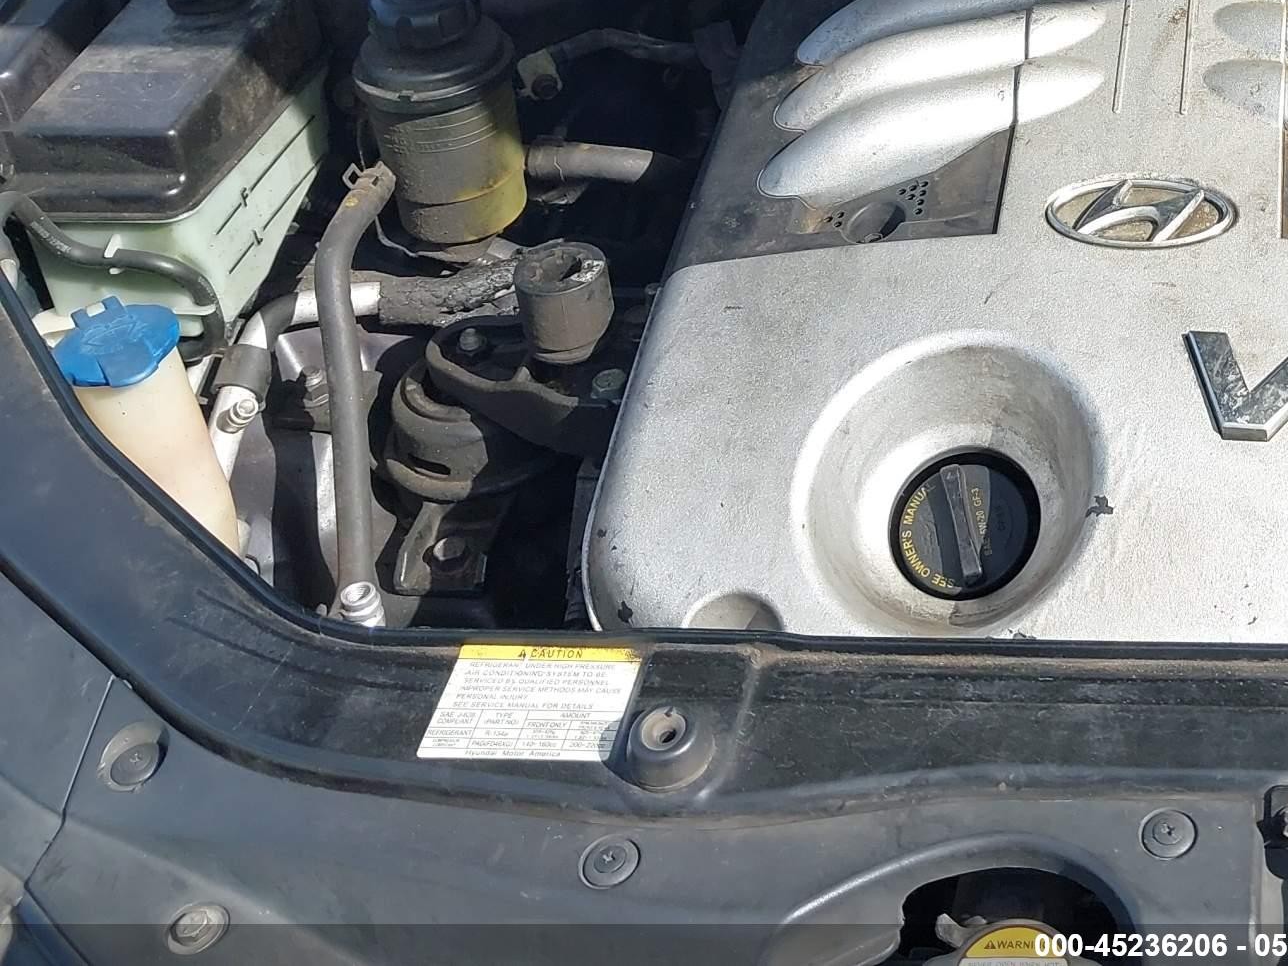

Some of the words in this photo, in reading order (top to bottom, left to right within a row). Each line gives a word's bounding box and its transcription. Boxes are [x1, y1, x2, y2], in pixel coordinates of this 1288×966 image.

[903, 482, 937, 526] MANUAL
[902, 530, 931, 578] OWNER'S
[932, 573, 957, 588] SEE
[530, 648, 583, 659] CAUTION
